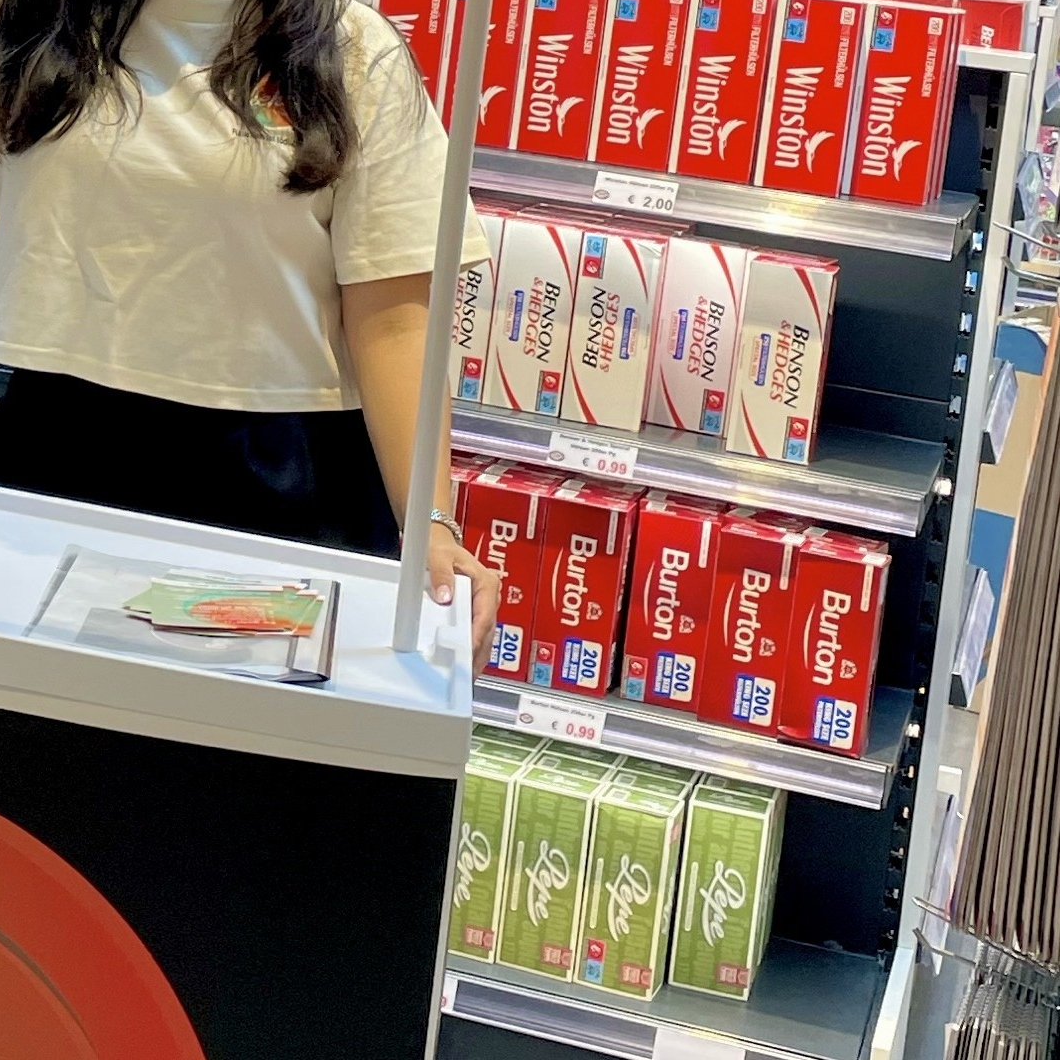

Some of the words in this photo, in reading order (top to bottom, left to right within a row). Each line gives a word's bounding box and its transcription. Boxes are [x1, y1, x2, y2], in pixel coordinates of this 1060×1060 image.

[527, 34, 574, 133] Winston
[606, 45, 654, 145] Winston
[687, 56, 736, 157] Winston
[774, 67, 824, 168] Winston
[861, 76, 912, 177] Winston
[643, 196, 673, 211] 2.00
[458, 270, 483, 349] BENSON
[534, 276, 543, 286] &
[698, 296, 708, 304] &
[524, 287, 544, 357] HEDGES
[536, 281, 561, 363] BENSON
[582, 286, 607, 369] BENSON
[600, 293, 621, 361] HEDGES
[688, 306, 707, 376] HEDGES
[701, 300, 725, 383] BENSON
[781, 320, 791, 329] &
[599, 362, 610, 373] &
[770, 331, 791, 403] HEDGES
[784, 324, 810, 409] BENSON
[598, 459, 627, 475] 0.99
[487, 519, 518, 608] Burt
[560, 533, 598, 627] Burton
[652, 547, 690, 641] Burton
[502, 633, 519, 662] 200
[732, 568, 771, 663] Burton
[812, 589, 852, 686] Burton
[581, 648, 598, 679] 200
[674, 662, 691, 692] 200
[566, 723, 595, 740] 0.99
[753, 685, 771, 716] 200
[834, 708, 852, 739] 200
